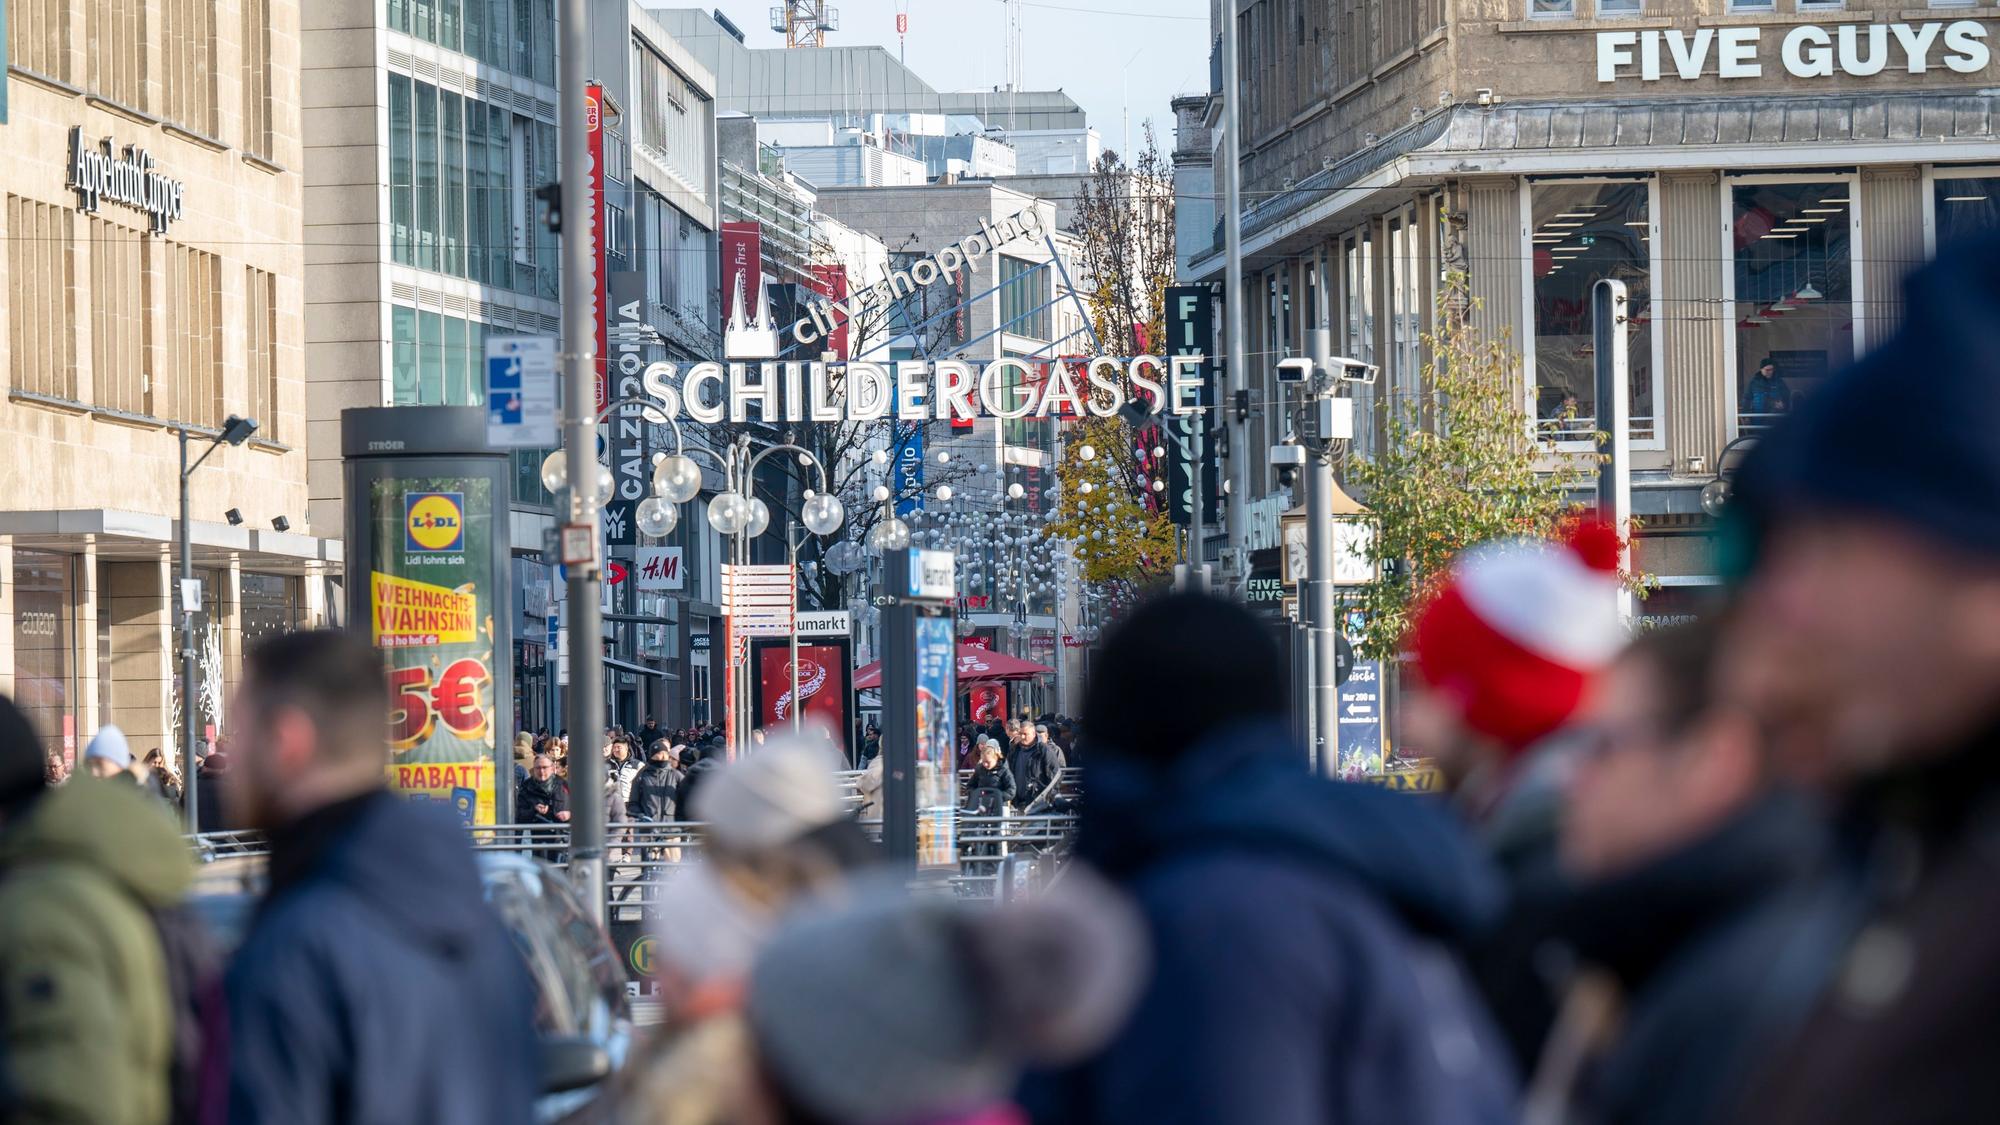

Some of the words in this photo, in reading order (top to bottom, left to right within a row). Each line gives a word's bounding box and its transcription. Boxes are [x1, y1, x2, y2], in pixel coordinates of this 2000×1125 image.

[1596, 26, 1762, 83] FIVE
[1781, 20, 1991, 78] GUYS
[70, 125, 184, 233] AppelrathCüpper
[793, 299, 855, 344] city
[872, 204, 1047, 306] shopping
[619, 300, 642, 500] CALZEDONIA
[642, 354, 1207, 424] SCHILDERGASSE
[368, 440, 406, 451] STRÖER
[405, 555, 422, 565] Lidl
[423, 555, 446, 565] lohnt
[448, 555, 465, 565] sich
[642, 556, 678, 581] H&M
[377, 582, 472, 611] WEIHNACHTS-
[1247, 590, 1284, 602] GUYS
[1248, 578, 1281, 590] FIVE
[378, 606, 472, 631] WAHNSINN
[797, 616, 847, 632] umarkt
[399, 766, 483, 789] RABATT
